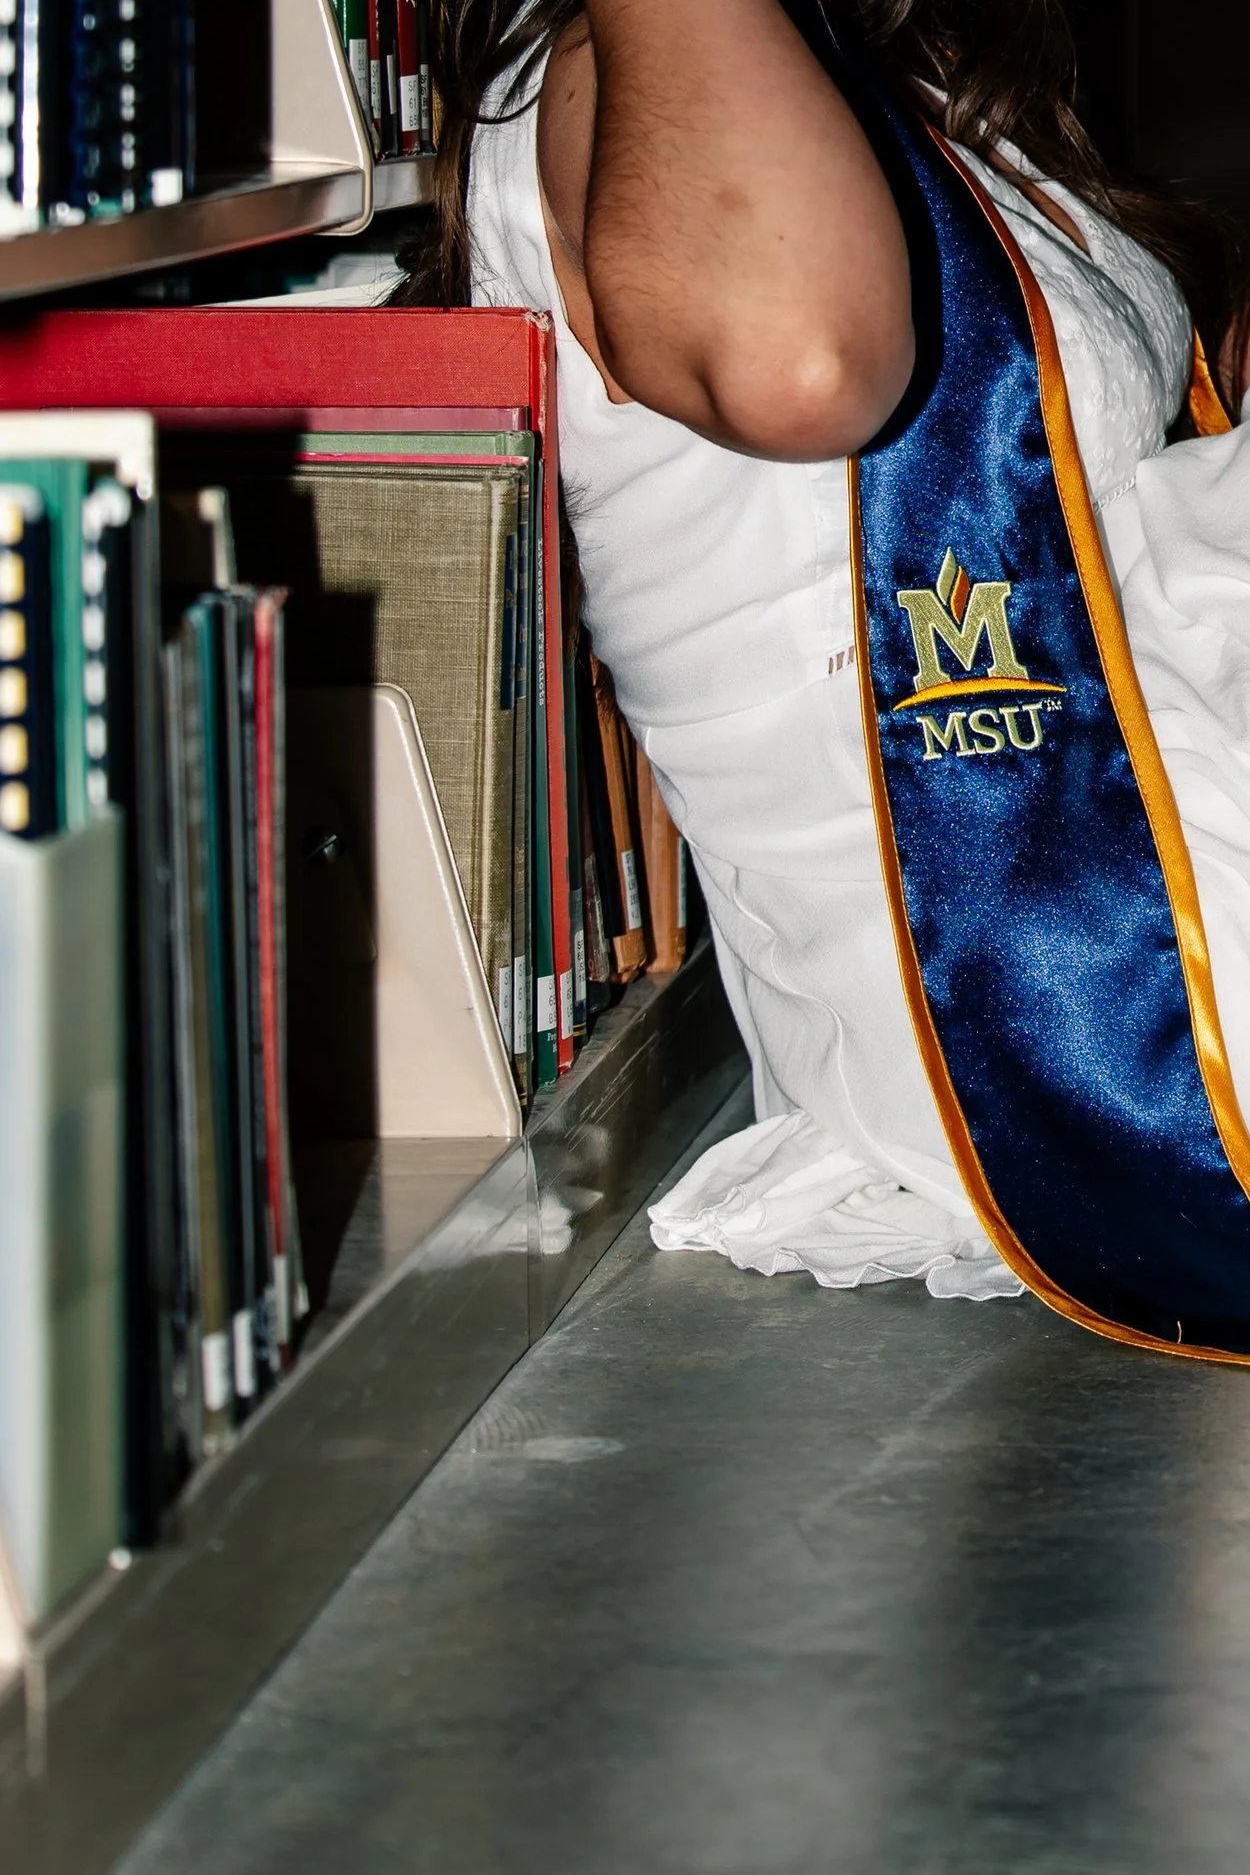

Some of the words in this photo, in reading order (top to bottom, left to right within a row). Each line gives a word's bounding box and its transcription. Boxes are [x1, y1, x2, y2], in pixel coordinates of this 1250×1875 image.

[536, 537, 544, 624] Livestock
[897, 581, 1029, 693] M
[916, 702, 1042, 761] MSU
